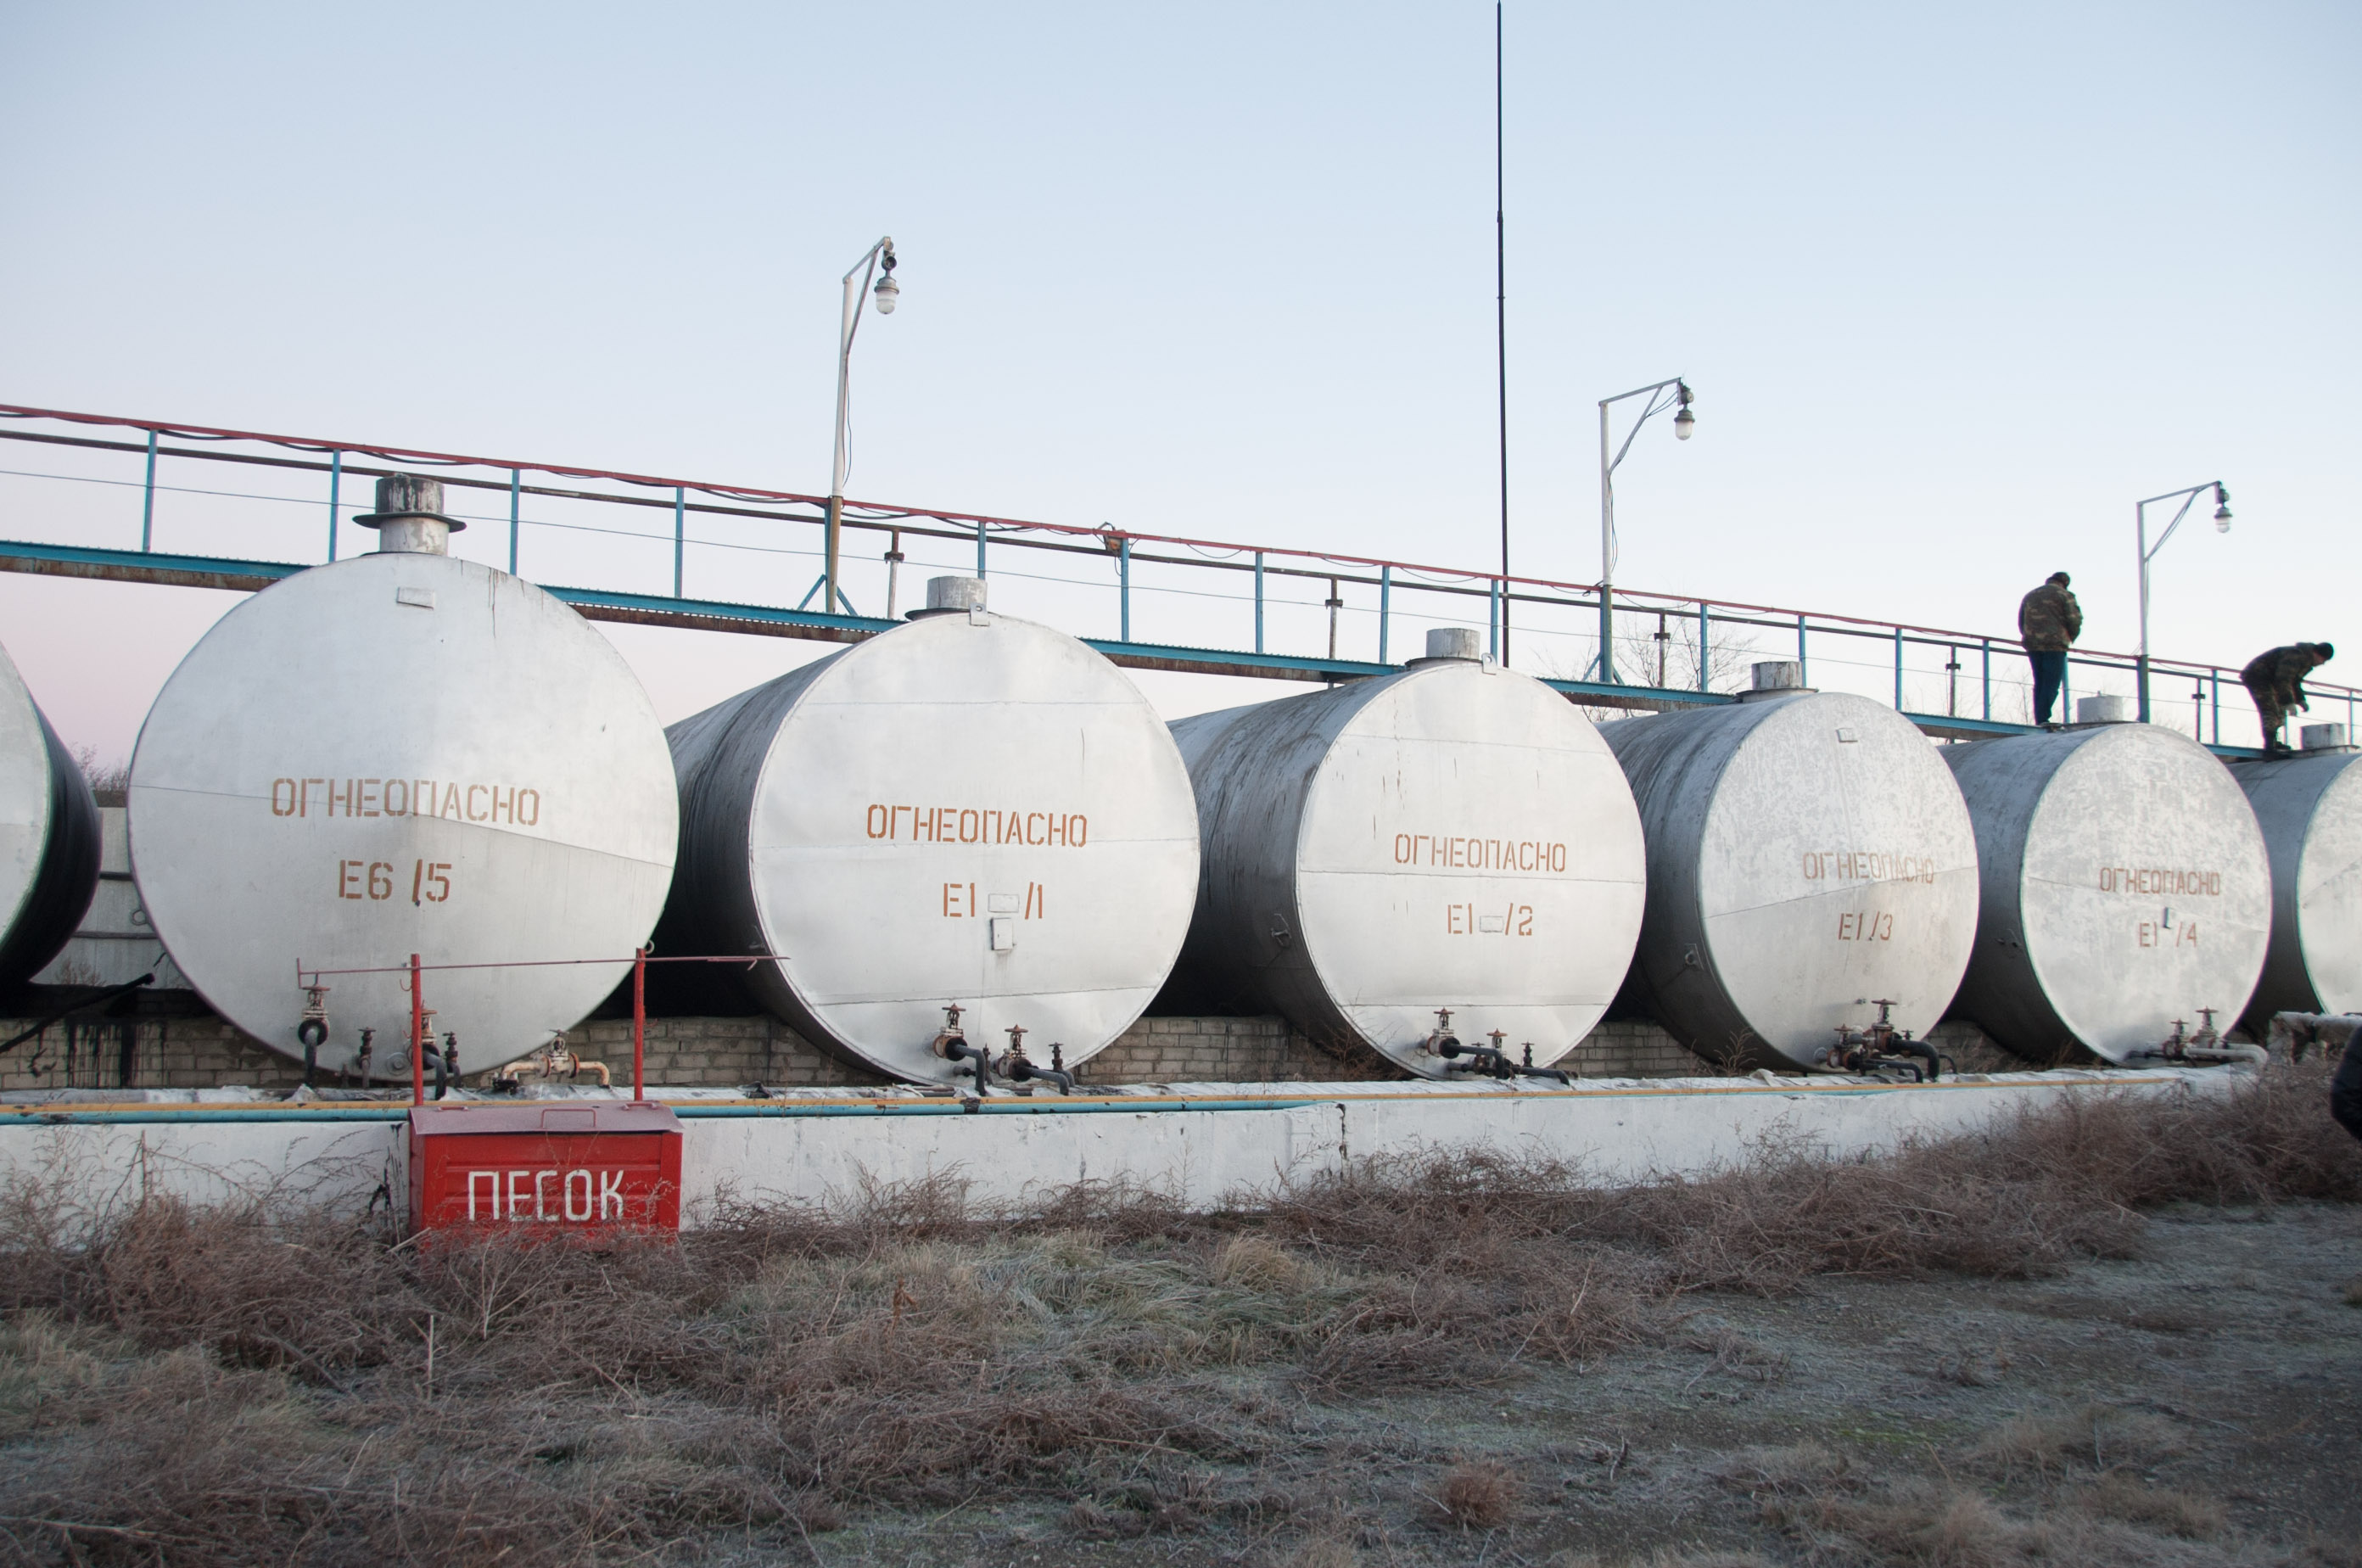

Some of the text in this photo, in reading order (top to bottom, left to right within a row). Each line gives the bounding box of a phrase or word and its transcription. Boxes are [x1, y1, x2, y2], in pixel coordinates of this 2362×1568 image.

[272, 778, 540, 826] ОГНЕОПАСНО
[867, 804, 1087, 848] ОГНЕОПАСНО
[1395, 834, 1565, 872] ОГНЕОПАСНО
[1803, 852, 1934, 884] ОГНЕОПАСНО
[2100, 867, 2220, 896] ОГНЕОПАСНО
[468, 1169, 624, 1222] ПЕСОК
